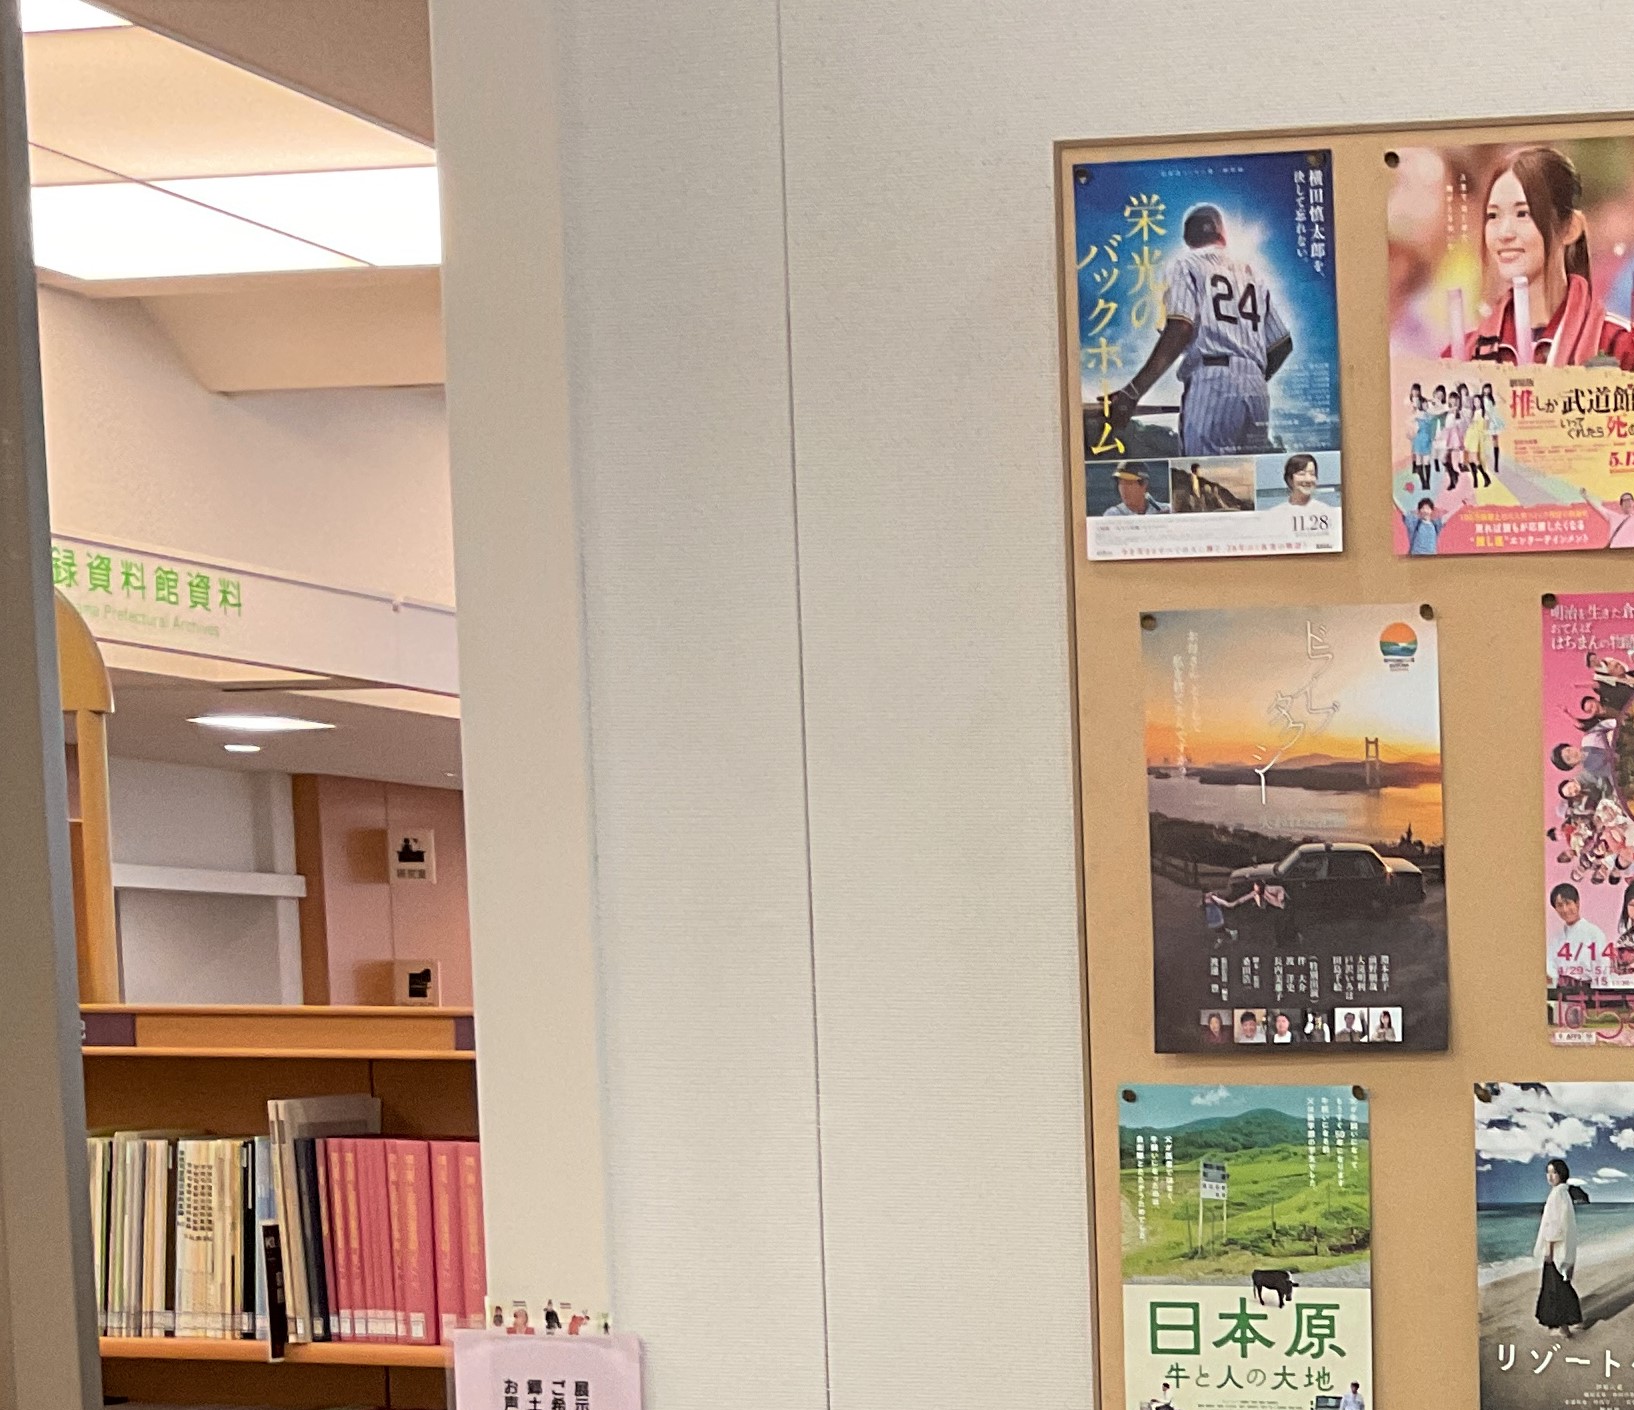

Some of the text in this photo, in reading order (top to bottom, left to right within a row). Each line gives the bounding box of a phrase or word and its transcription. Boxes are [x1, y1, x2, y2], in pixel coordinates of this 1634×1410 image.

[1123, 192, 1168, 331] 栄光の
[1210, 273, 1262, 332] 24
[1077, 232, 1127, 456] バックホーム
[1291, 514, 1330, 533] 11.28
[1557, 942, 1618, 962] 4/14
[1149, 1296, 1347, 1359] 日本原
[1164, 1361, 1336, 1392] 牛と人の大地
